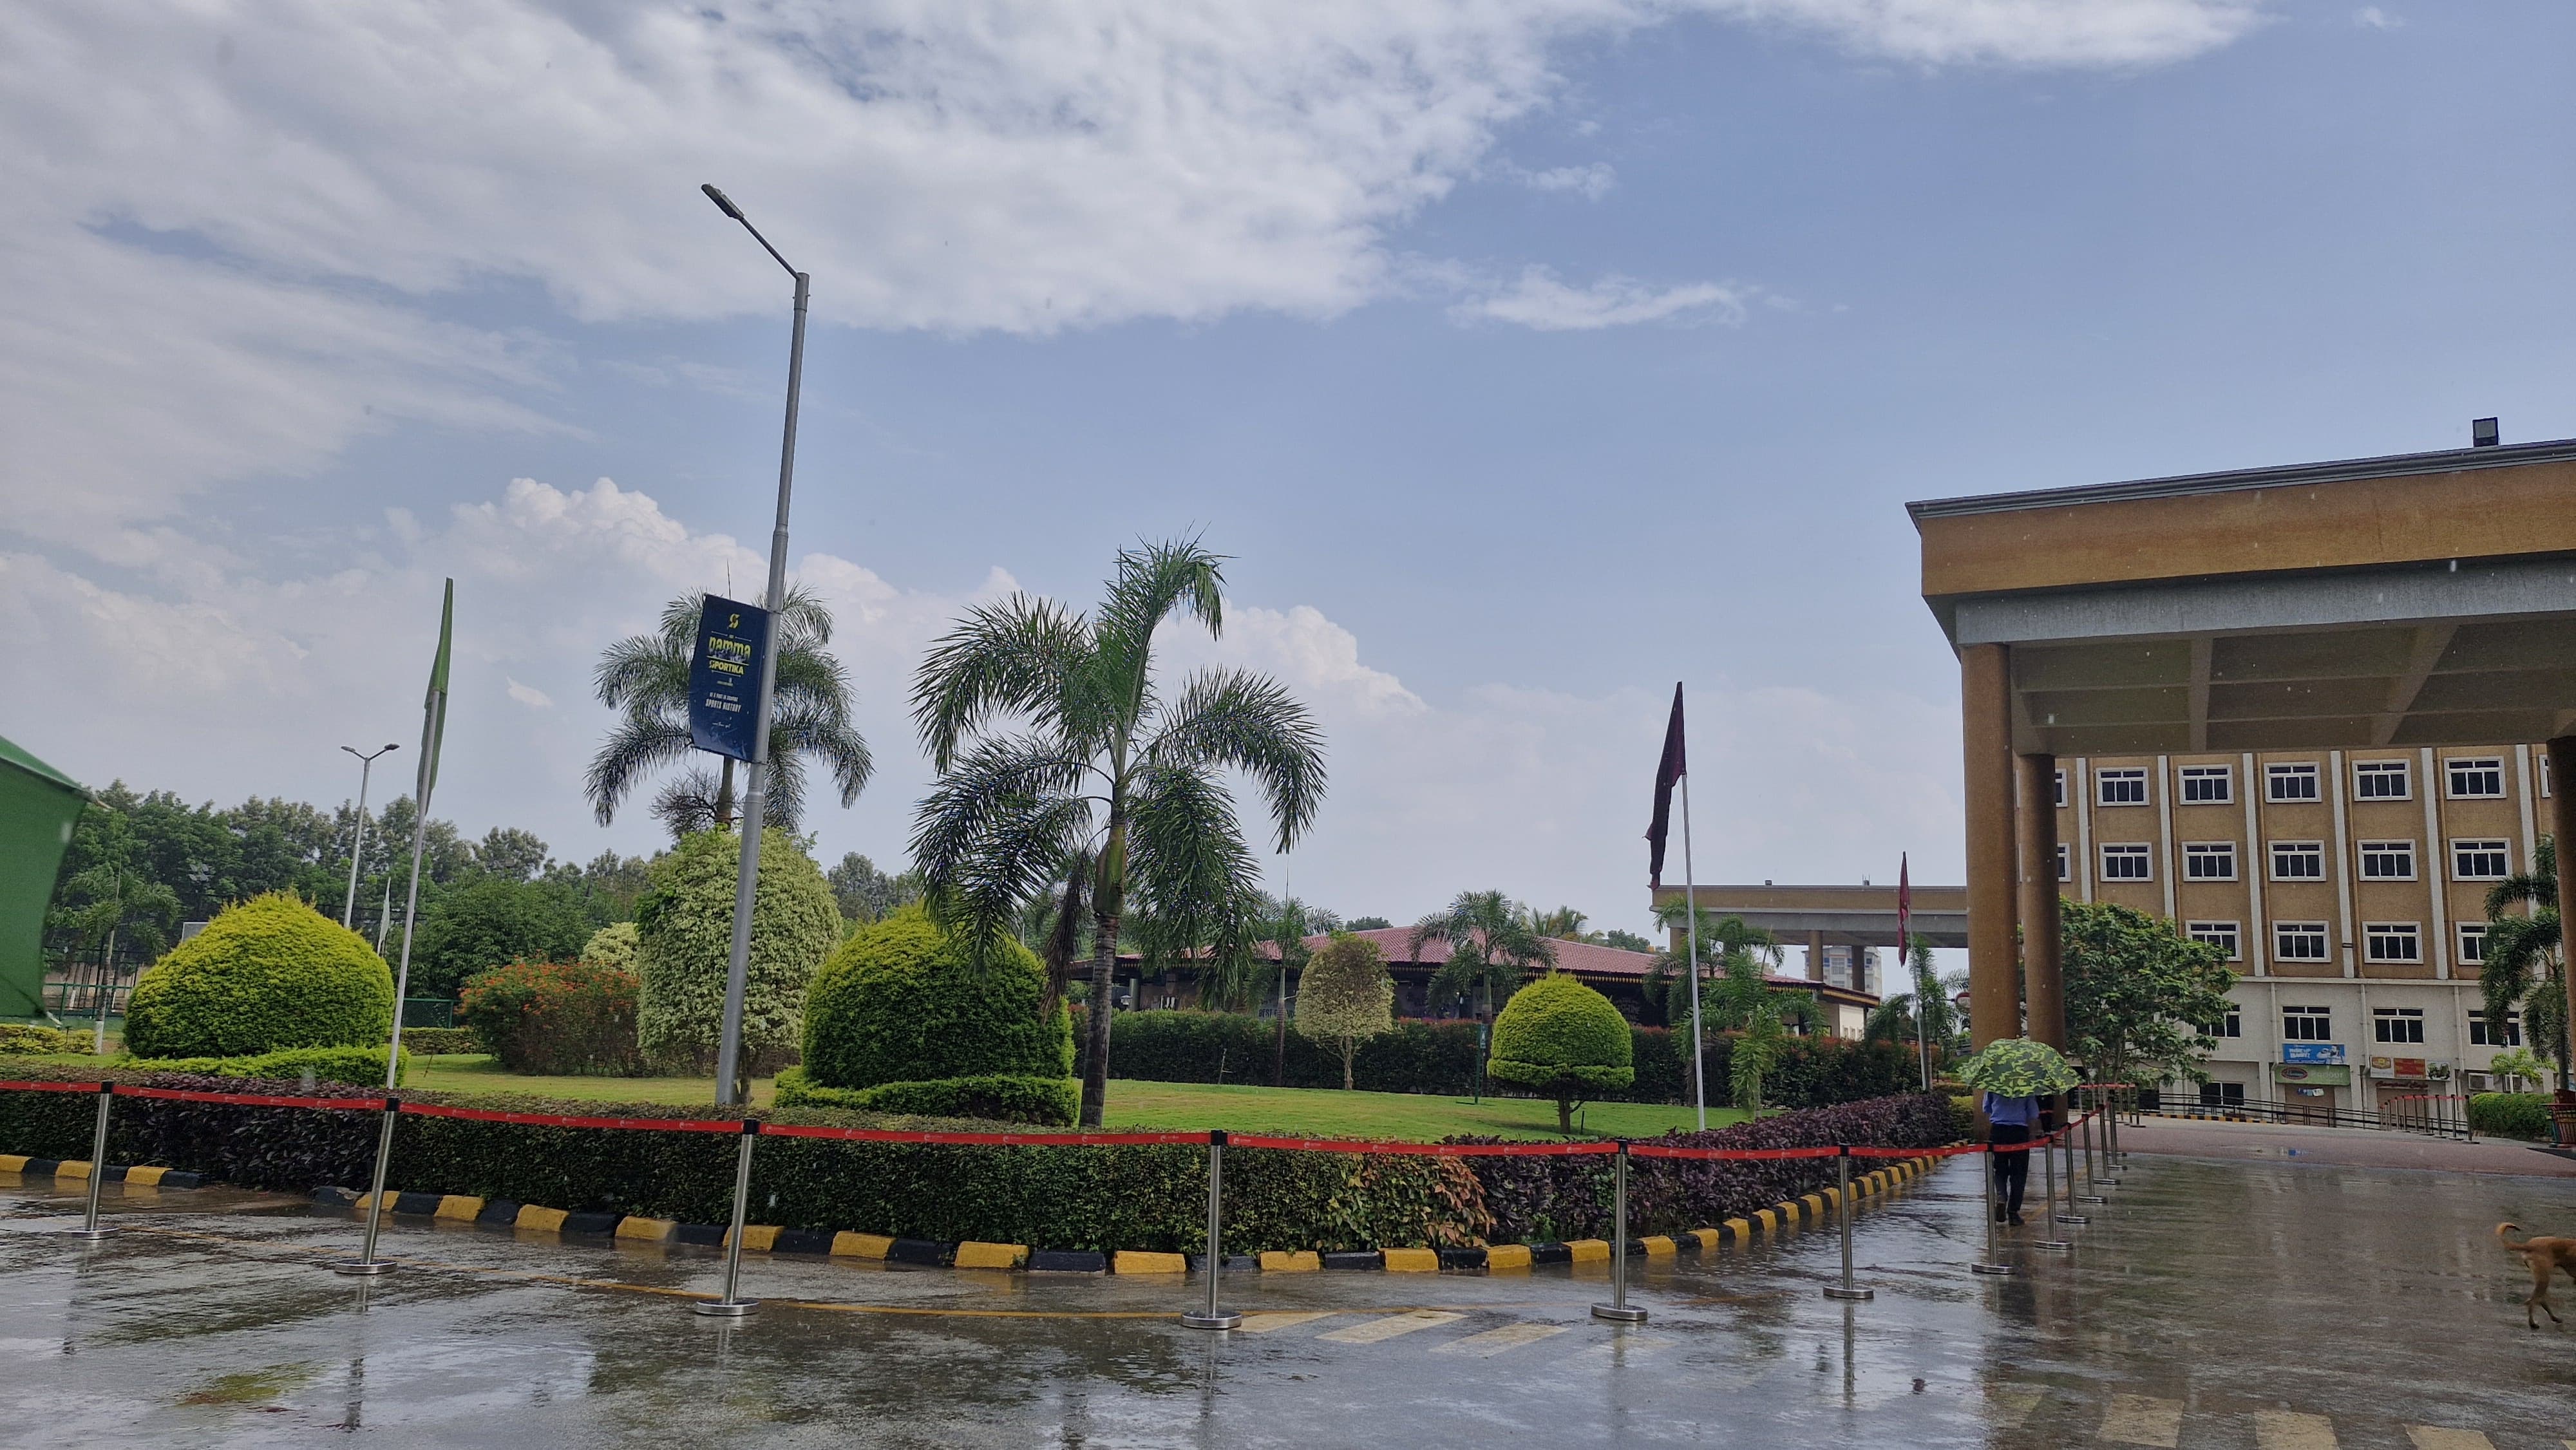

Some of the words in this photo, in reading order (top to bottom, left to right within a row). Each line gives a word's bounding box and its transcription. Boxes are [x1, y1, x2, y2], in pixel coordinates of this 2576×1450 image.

[708, 660, 744, 675] SPORTIKA
[705, 699, 722, 709] SPORTS
[722, 702, 741, 713] HISTORY
